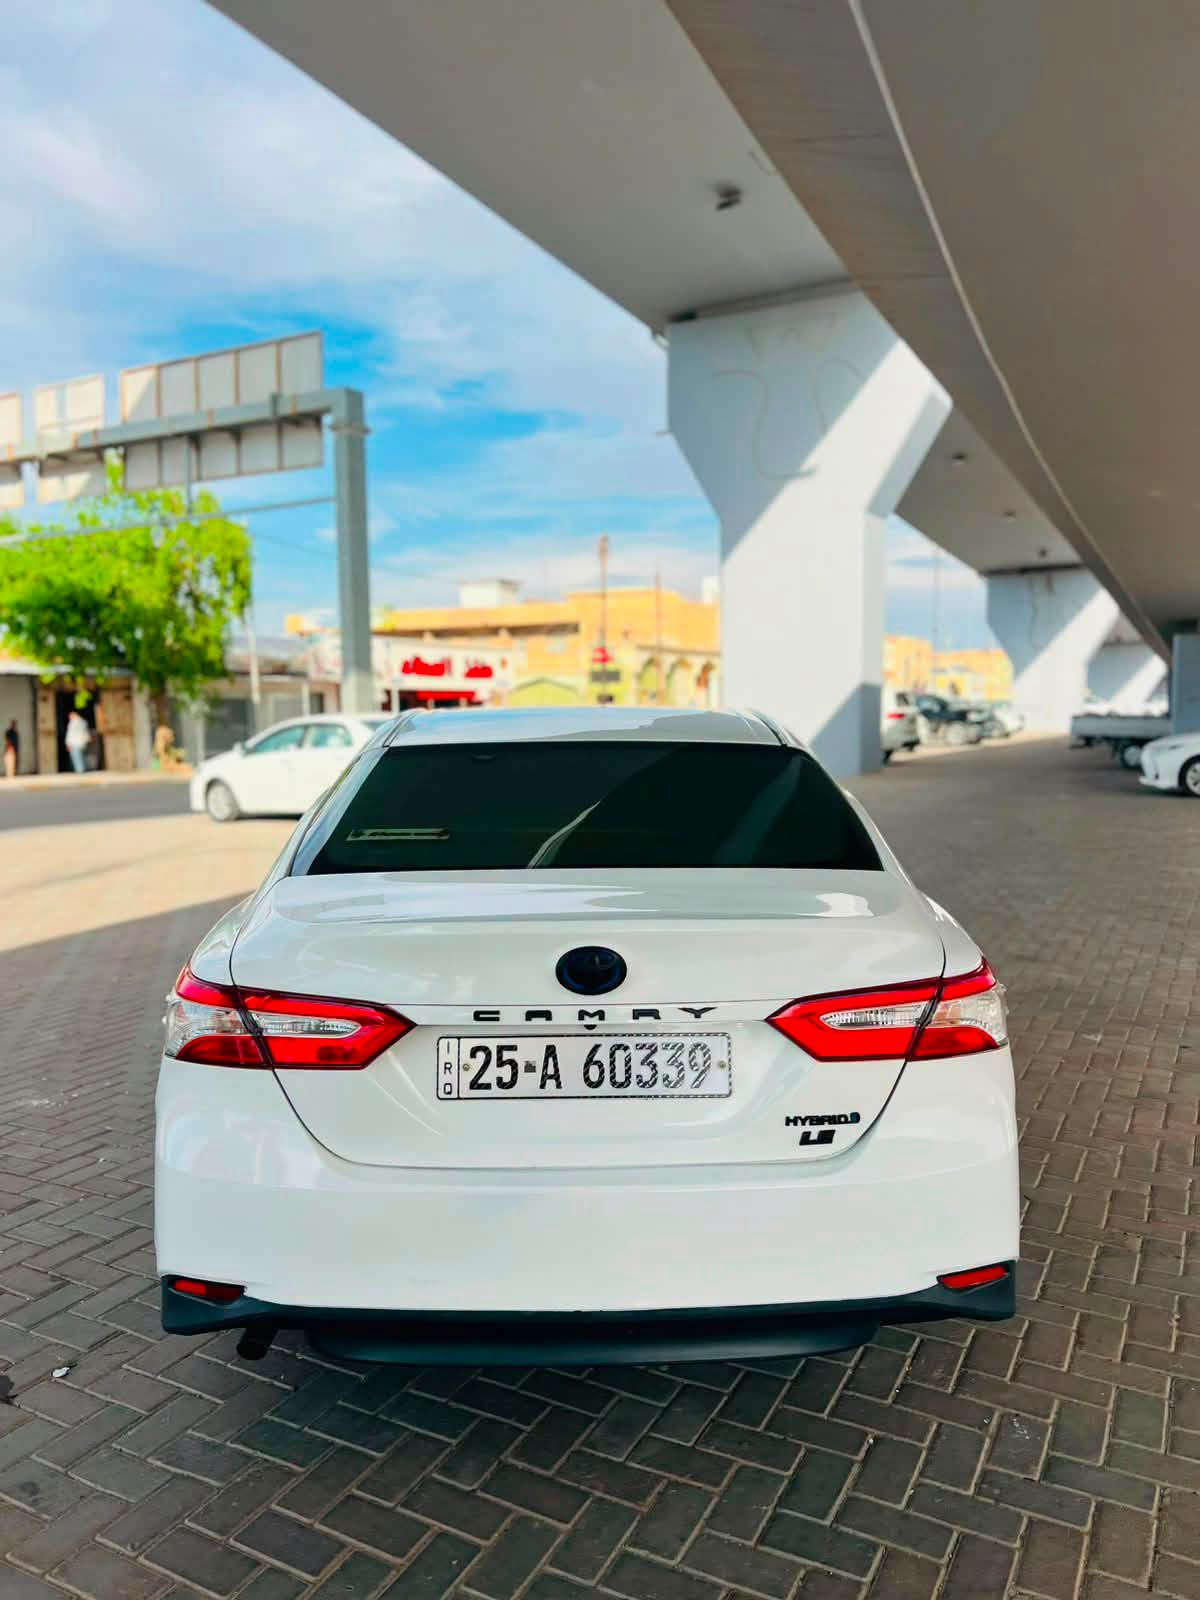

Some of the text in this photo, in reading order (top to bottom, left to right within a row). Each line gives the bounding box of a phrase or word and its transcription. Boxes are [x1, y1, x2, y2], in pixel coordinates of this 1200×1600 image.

[473, 1007, 717, 1022] CAMRY
[582, 1042, 712, 1090] 60339
[785, 1114, 849, 1126] HYBRID
[799, 1130, 836, 1146] LE
